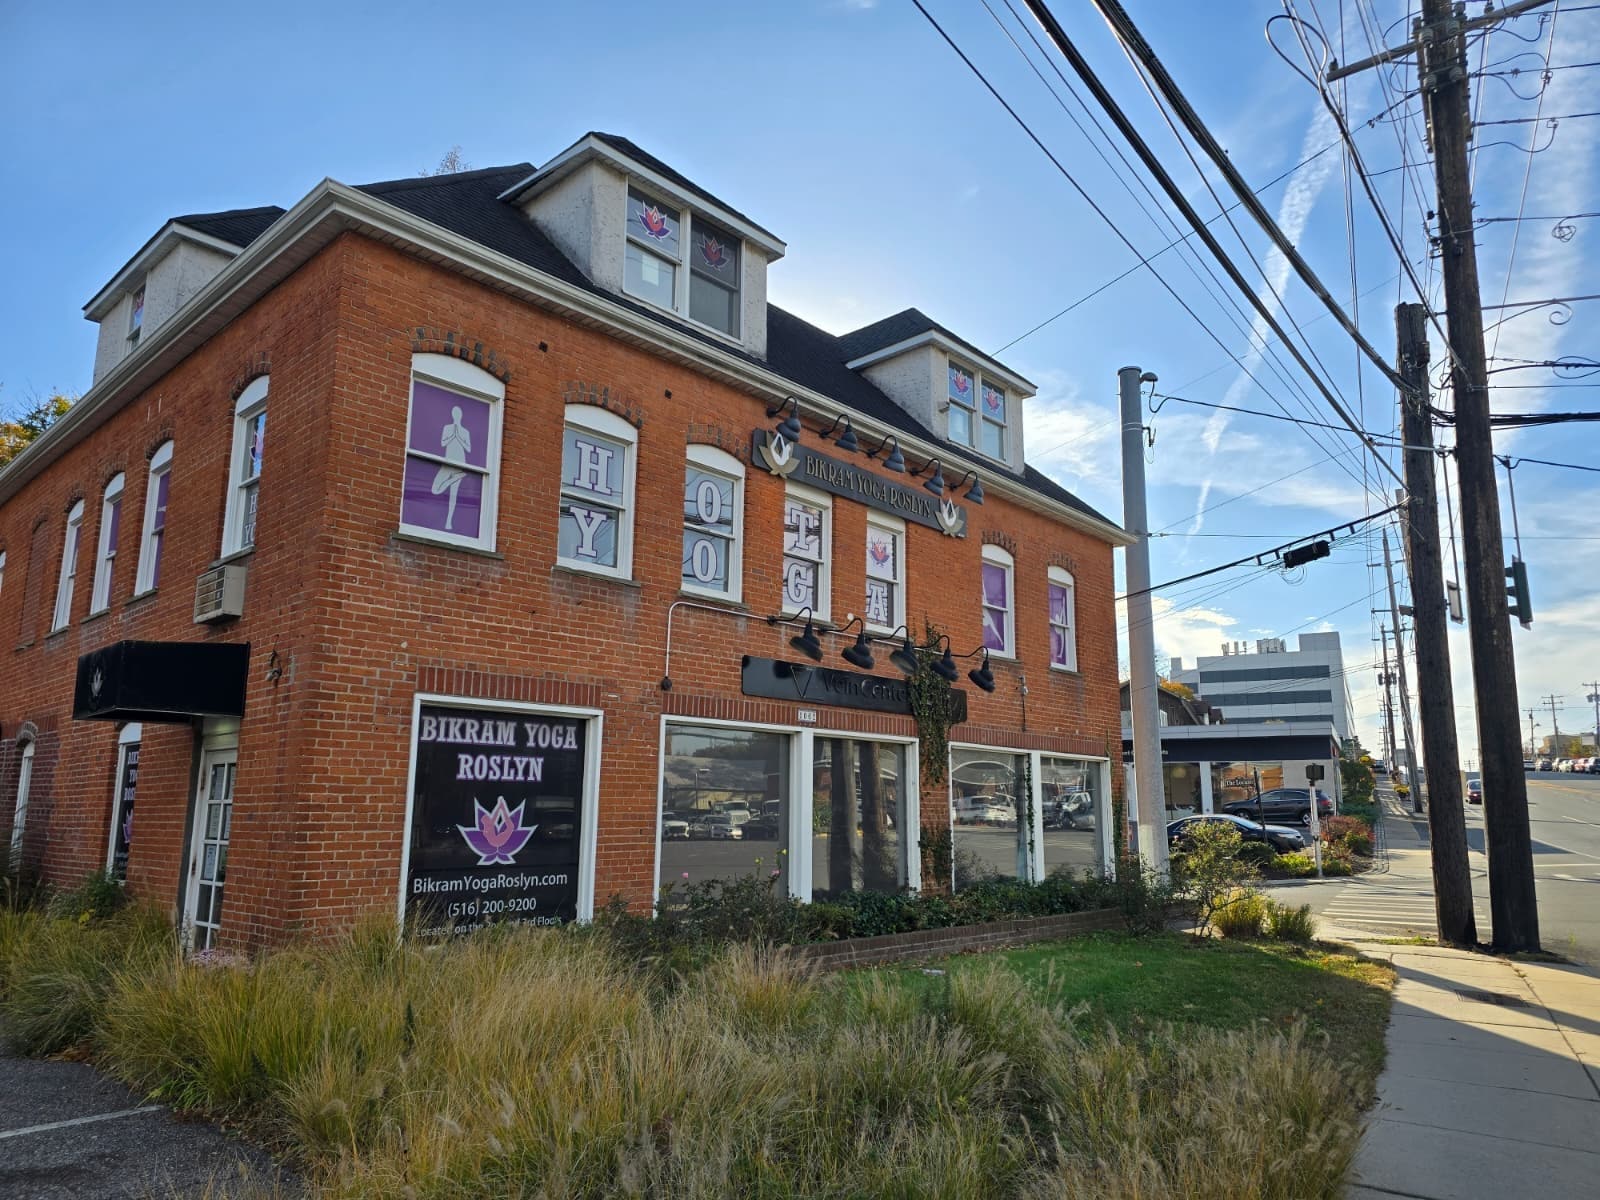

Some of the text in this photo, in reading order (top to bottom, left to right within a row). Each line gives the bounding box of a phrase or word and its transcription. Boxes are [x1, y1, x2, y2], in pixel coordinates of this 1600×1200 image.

[805, 455, 931, 519] BIKRAM YOGA ROSLYN
[420, 715, 578, 749] BIKRAM YOGA
[456, 753, 545, 782] ROSLYN
[413, 873, 568, 893] BikramYogaRoslyn.com
[448, 898, 537, 918] (516) 200-9200
[454, 925, 466, 934] on
